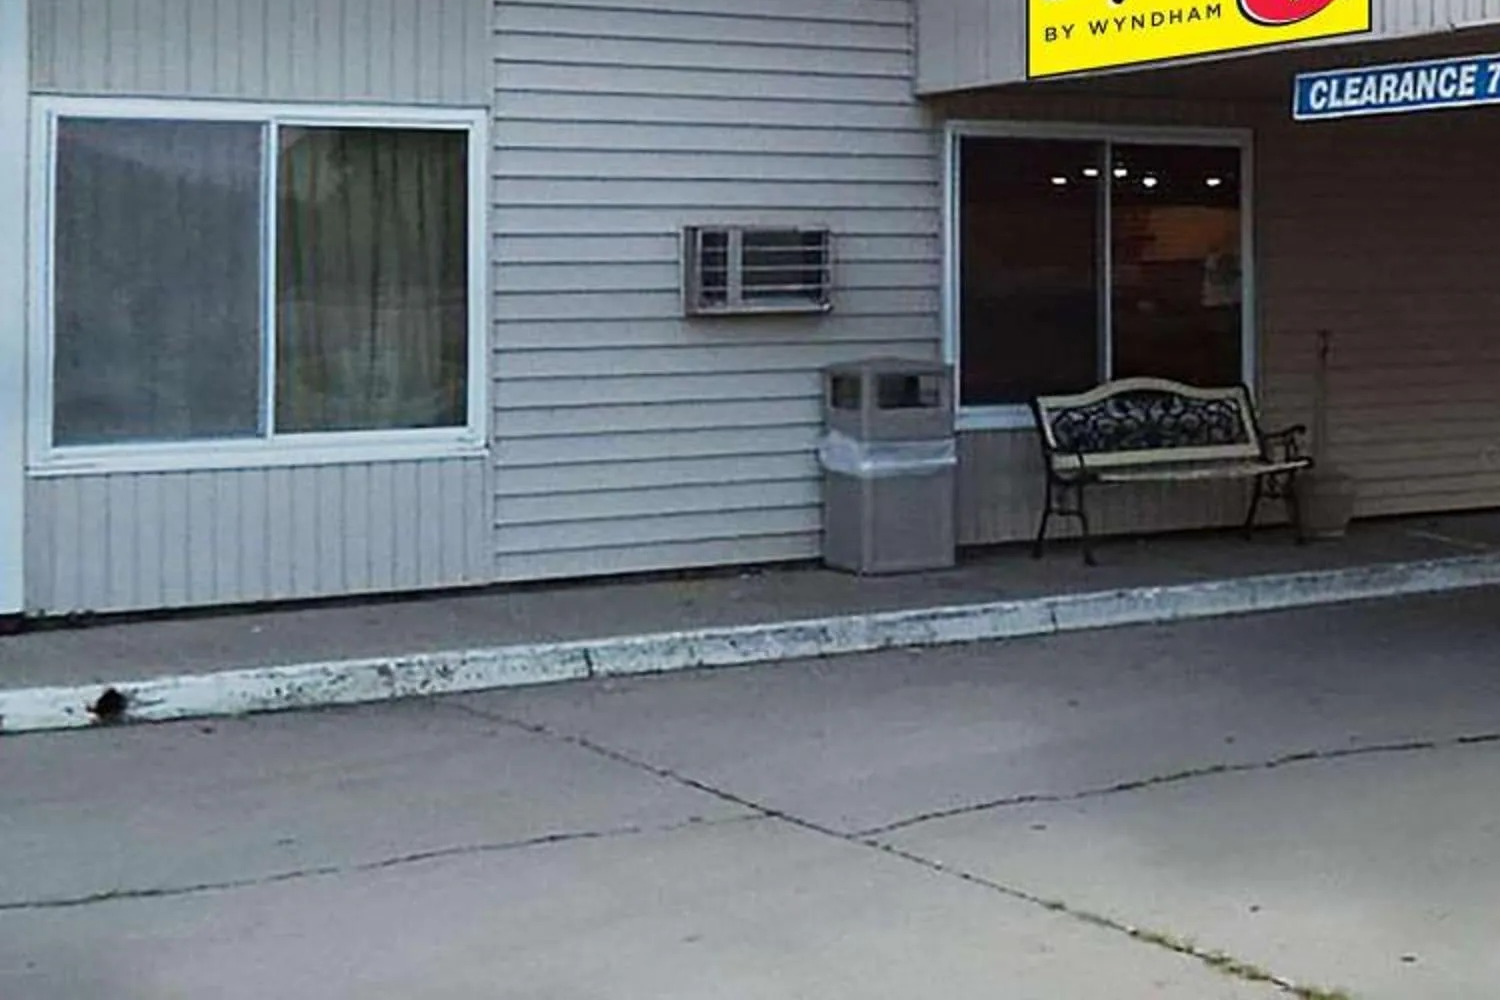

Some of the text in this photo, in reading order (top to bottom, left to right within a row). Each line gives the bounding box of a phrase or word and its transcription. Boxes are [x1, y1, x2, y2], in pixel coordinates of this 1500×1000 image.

[1044, 4, 1223, 43] BY WYNDHAM
[1309, 67, 1476, 111] CLEARANCE
